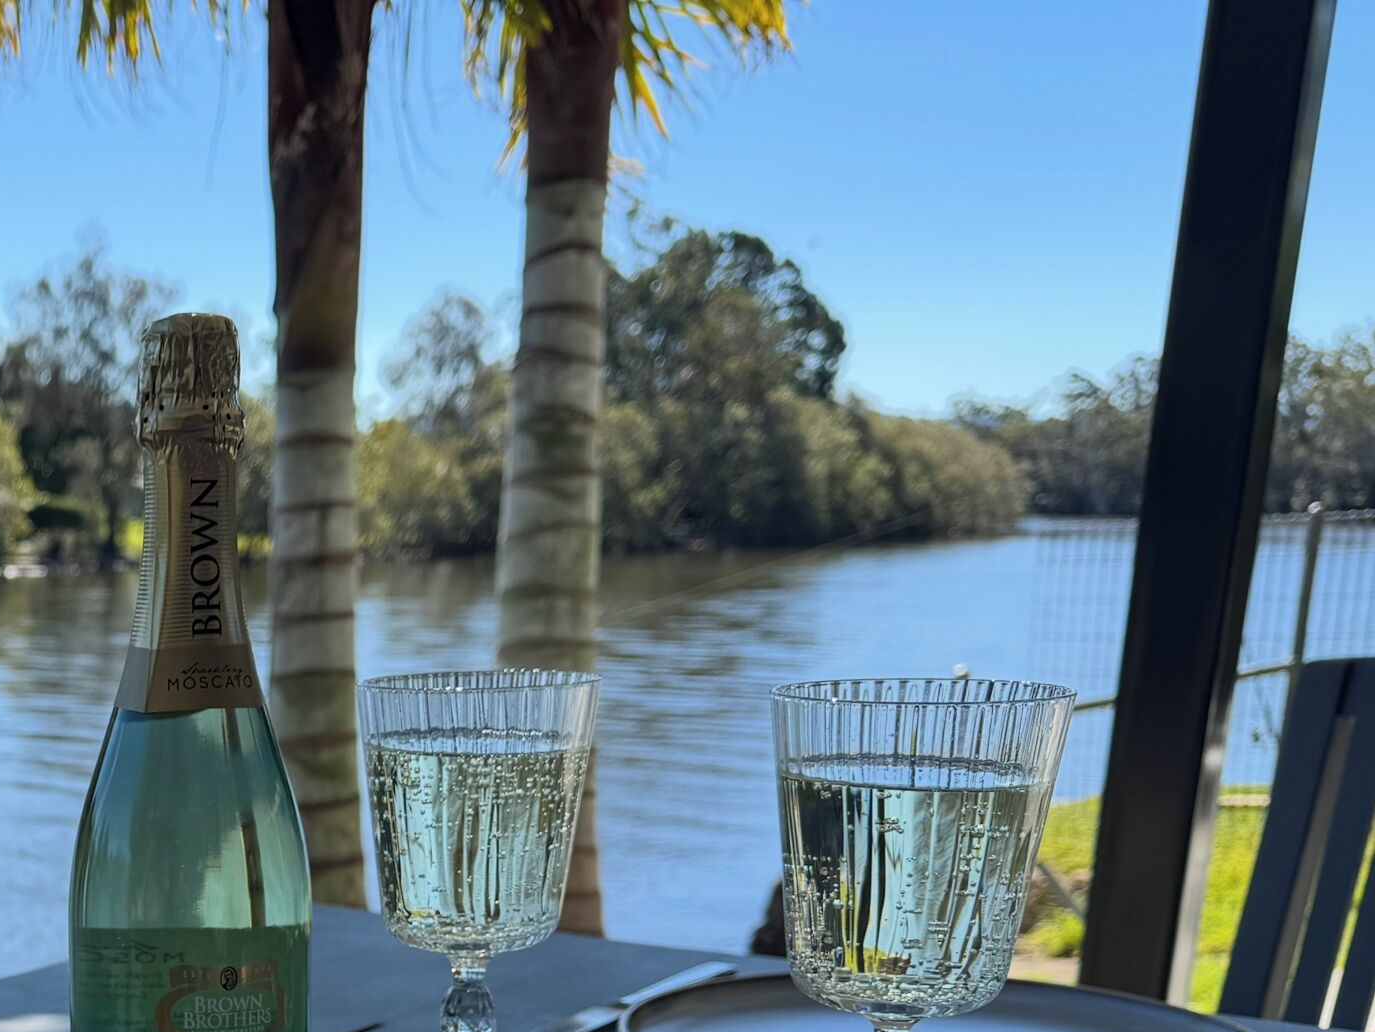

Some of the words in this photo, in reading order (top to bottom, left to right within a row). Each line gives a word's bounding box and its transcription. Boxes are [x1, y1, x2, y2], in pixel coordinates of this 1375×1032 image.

[190, 477, 223, 641] BROWN
[167, 674, 254, 692] MOSCATO
[194, 992, 263, 1014] BROWN
[183, 1007, 272, 1030] BROTHERS
